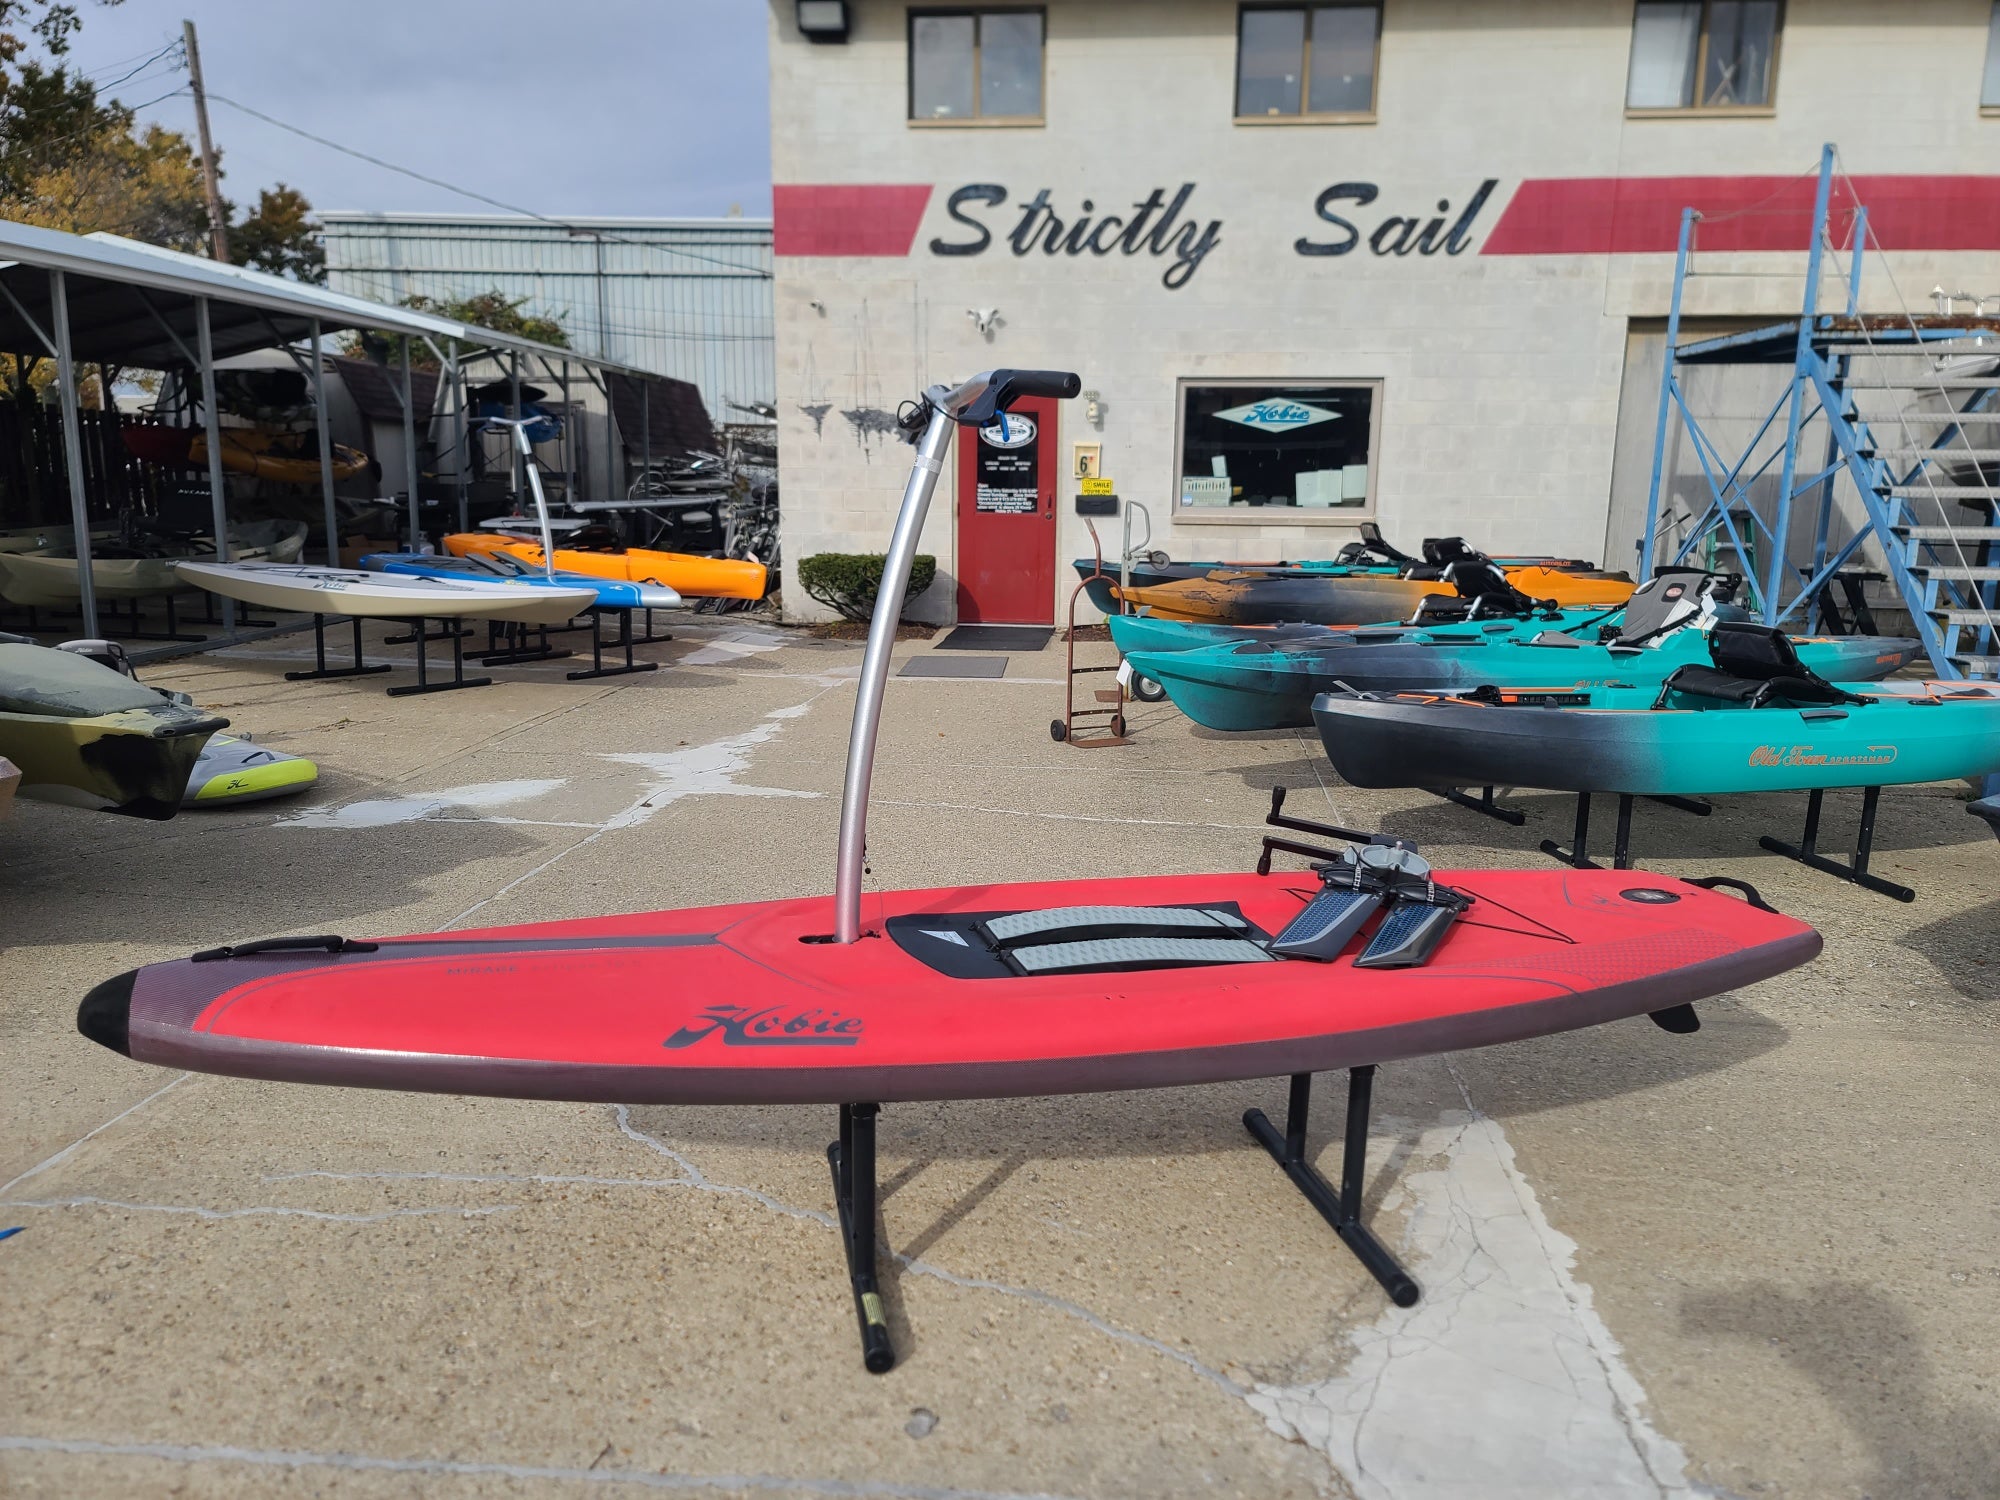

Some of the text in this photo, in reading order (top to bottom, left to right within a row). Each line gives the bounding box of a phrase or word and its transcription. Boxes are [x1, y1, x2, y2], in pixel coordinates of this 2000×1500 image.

[930, 179, 1499, 290] Strictly Sail
[1243, 404, 1310, 424] Hobie
[1749, 745, 1891, 766] Old Town SPORTSMAN
[662, 1004, 864, 1049] Hobie
